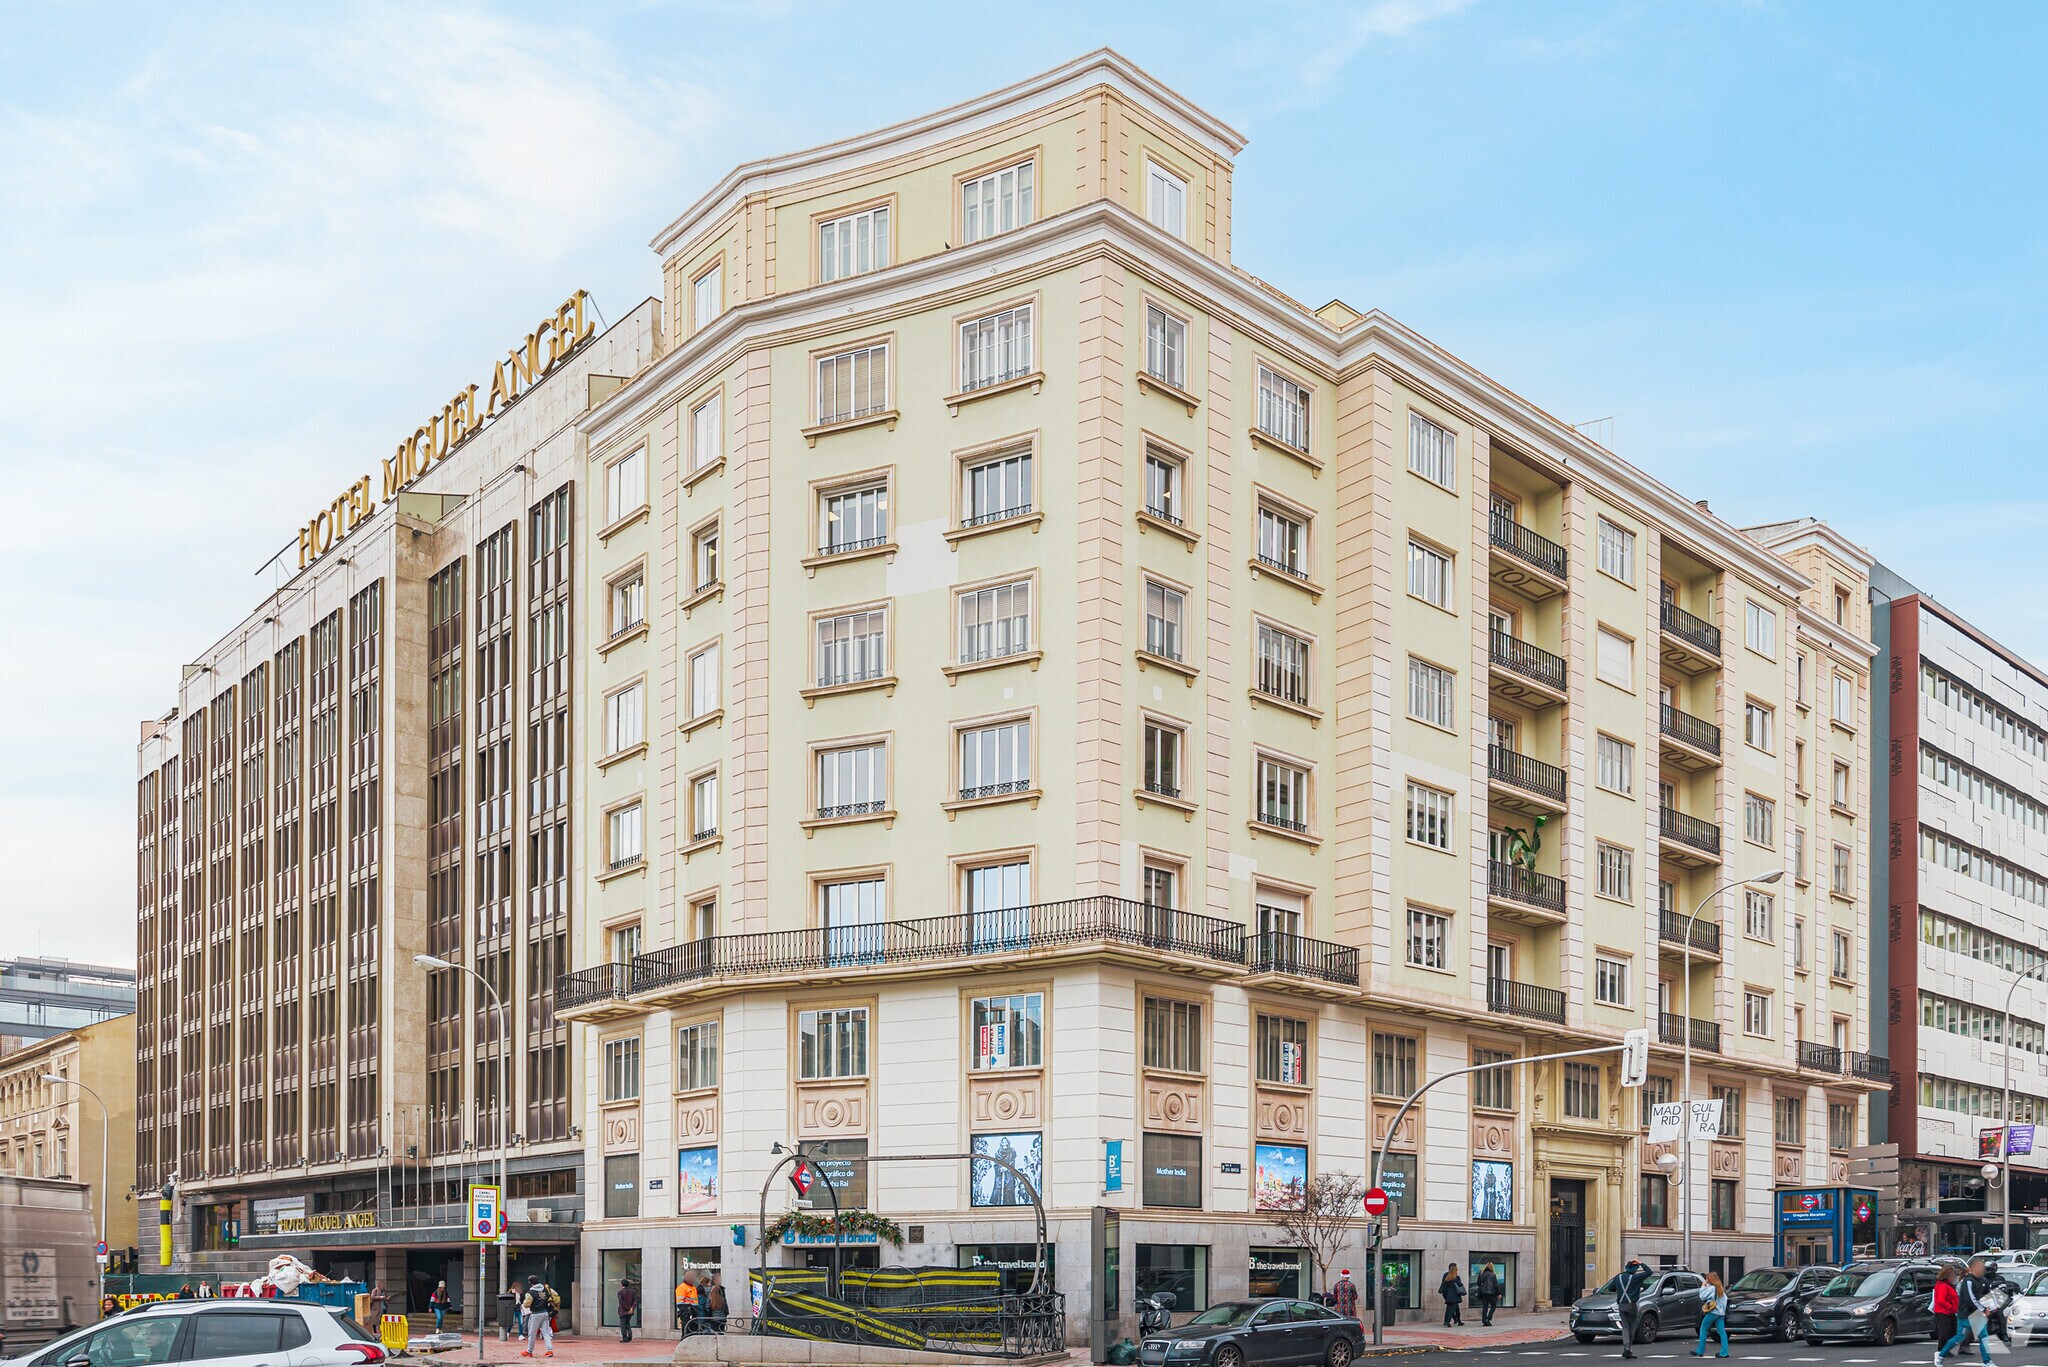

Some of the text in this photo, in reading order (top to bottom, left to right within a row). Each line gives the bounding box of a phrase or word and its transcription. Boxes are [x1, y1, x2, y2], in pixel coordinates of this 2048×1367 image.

[297, 289, 595, 570] HOTEL MIGUEL ANGEL
[1653, 1105, 1682, 1116] MAD
[1691, 1103, 1715, 1113] CUL
[1660, 1115, 1680, 1126] RID
[1694, 1112, 1710, 1122] TU
[1699, 1122, 1717, 1133] RA
[1156, 1167, 1187, 1176] Mother India
[280, 1211, 376, 1232] HOTEL MIGUEL ANGEL
[798, 1233, 815, 1244] the
[846, 1231, 877, 1243] brand
[998, 1260, 1020, 1269] travel
[1256, 1262, 1267, 1270] the
[1267, 1262, 1284, 1270] travel
[1284, 1262, 1302, 1270] brand
